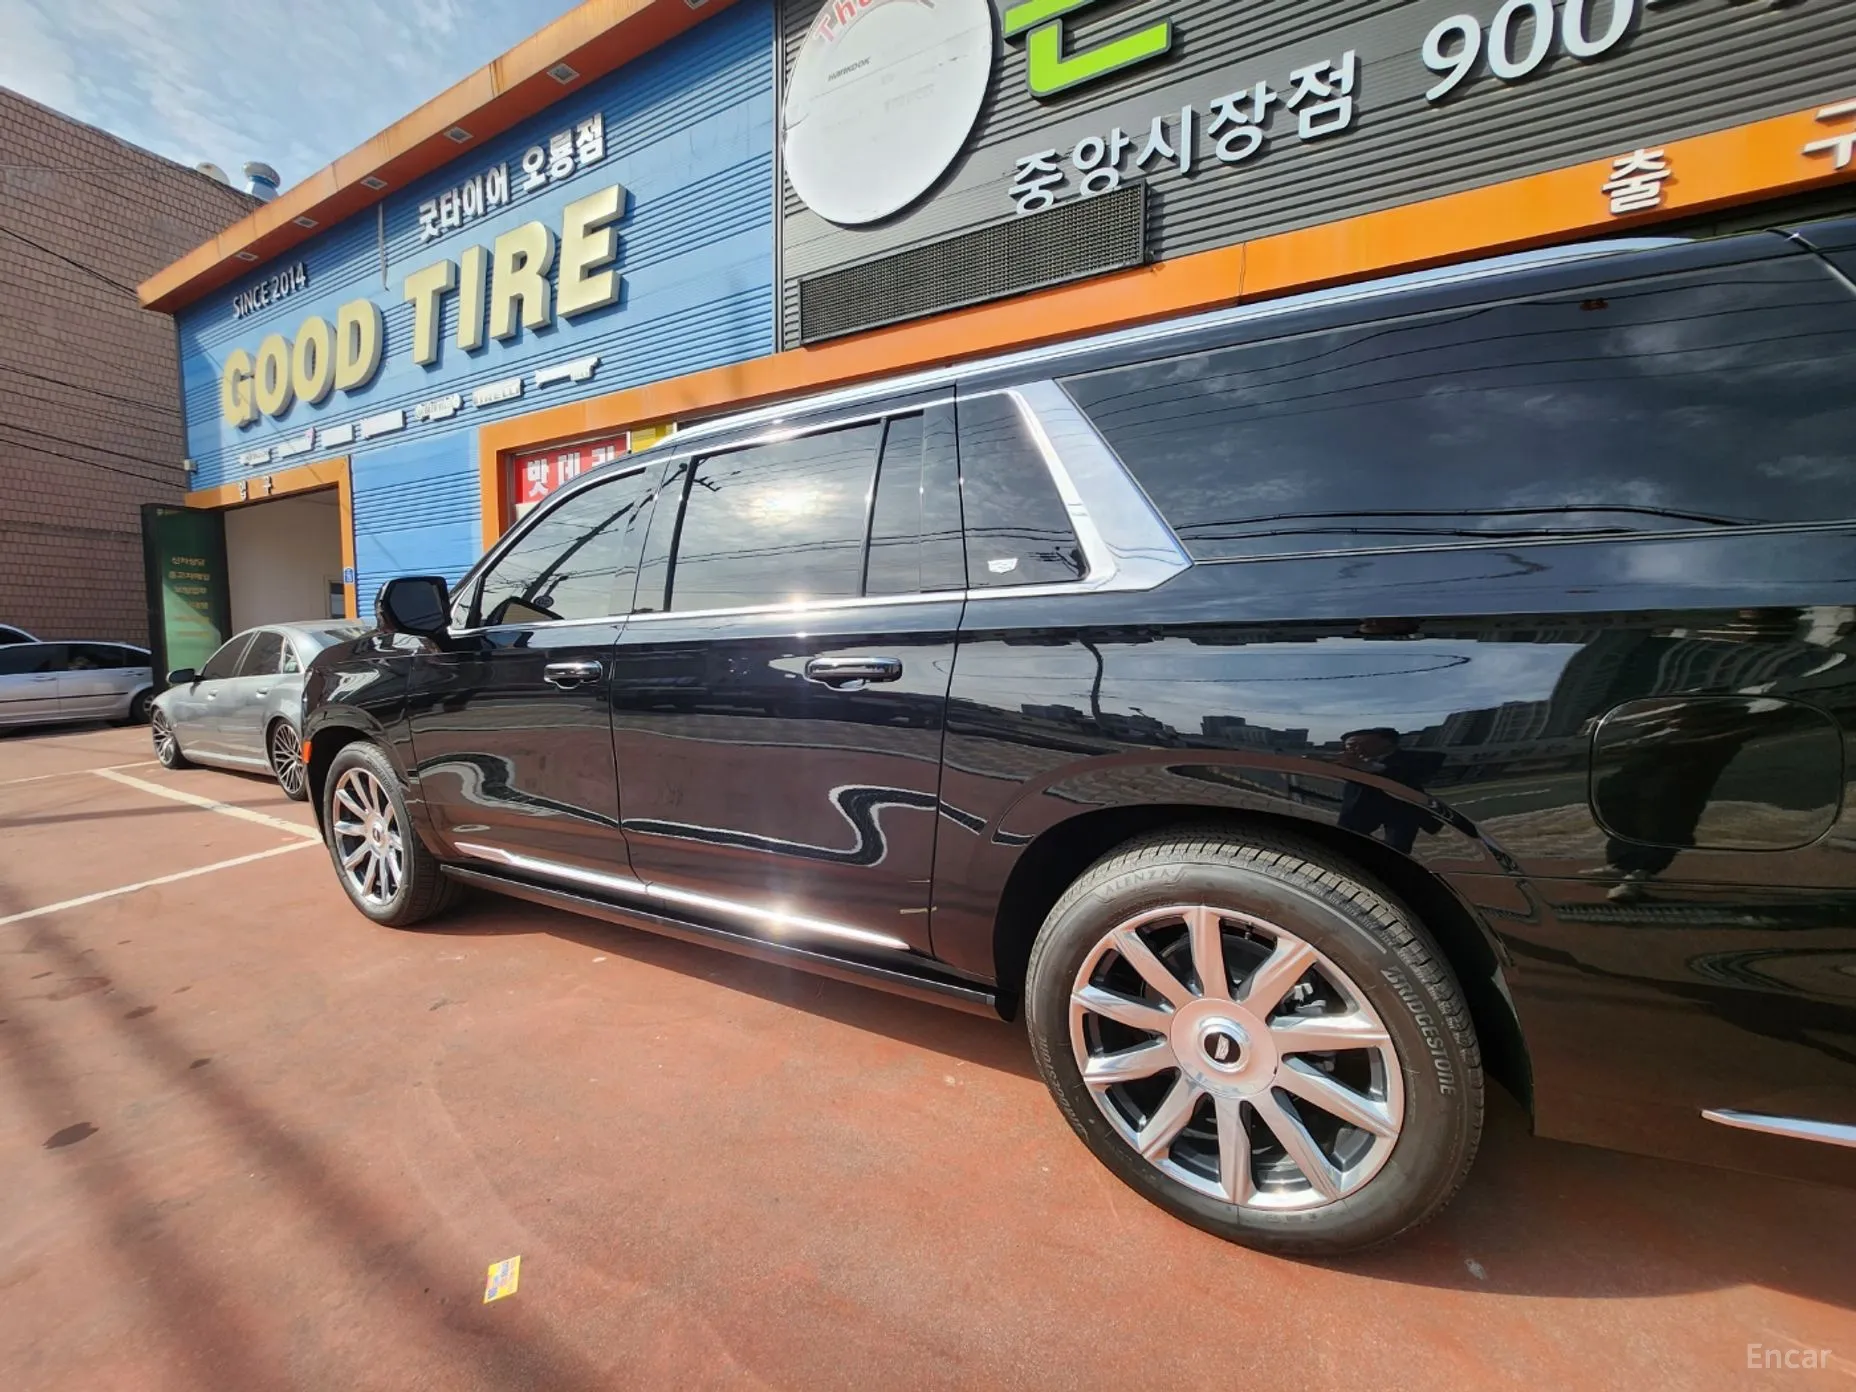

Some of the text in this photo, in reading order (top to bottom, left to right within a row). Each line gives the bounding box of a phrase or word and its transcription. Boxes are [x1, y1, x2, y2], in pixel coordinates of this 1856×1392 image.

[418, 113, 606, 243] 굿타이어 오룡점
[1008, 49, 1356, 215] 중앙시장점
[222, 183, 626, 428] GOOD TIRE
[233, 262, 306, 318] SINCE 2014
[1380, 965, 1456, 1096] BRIDGESTONE
